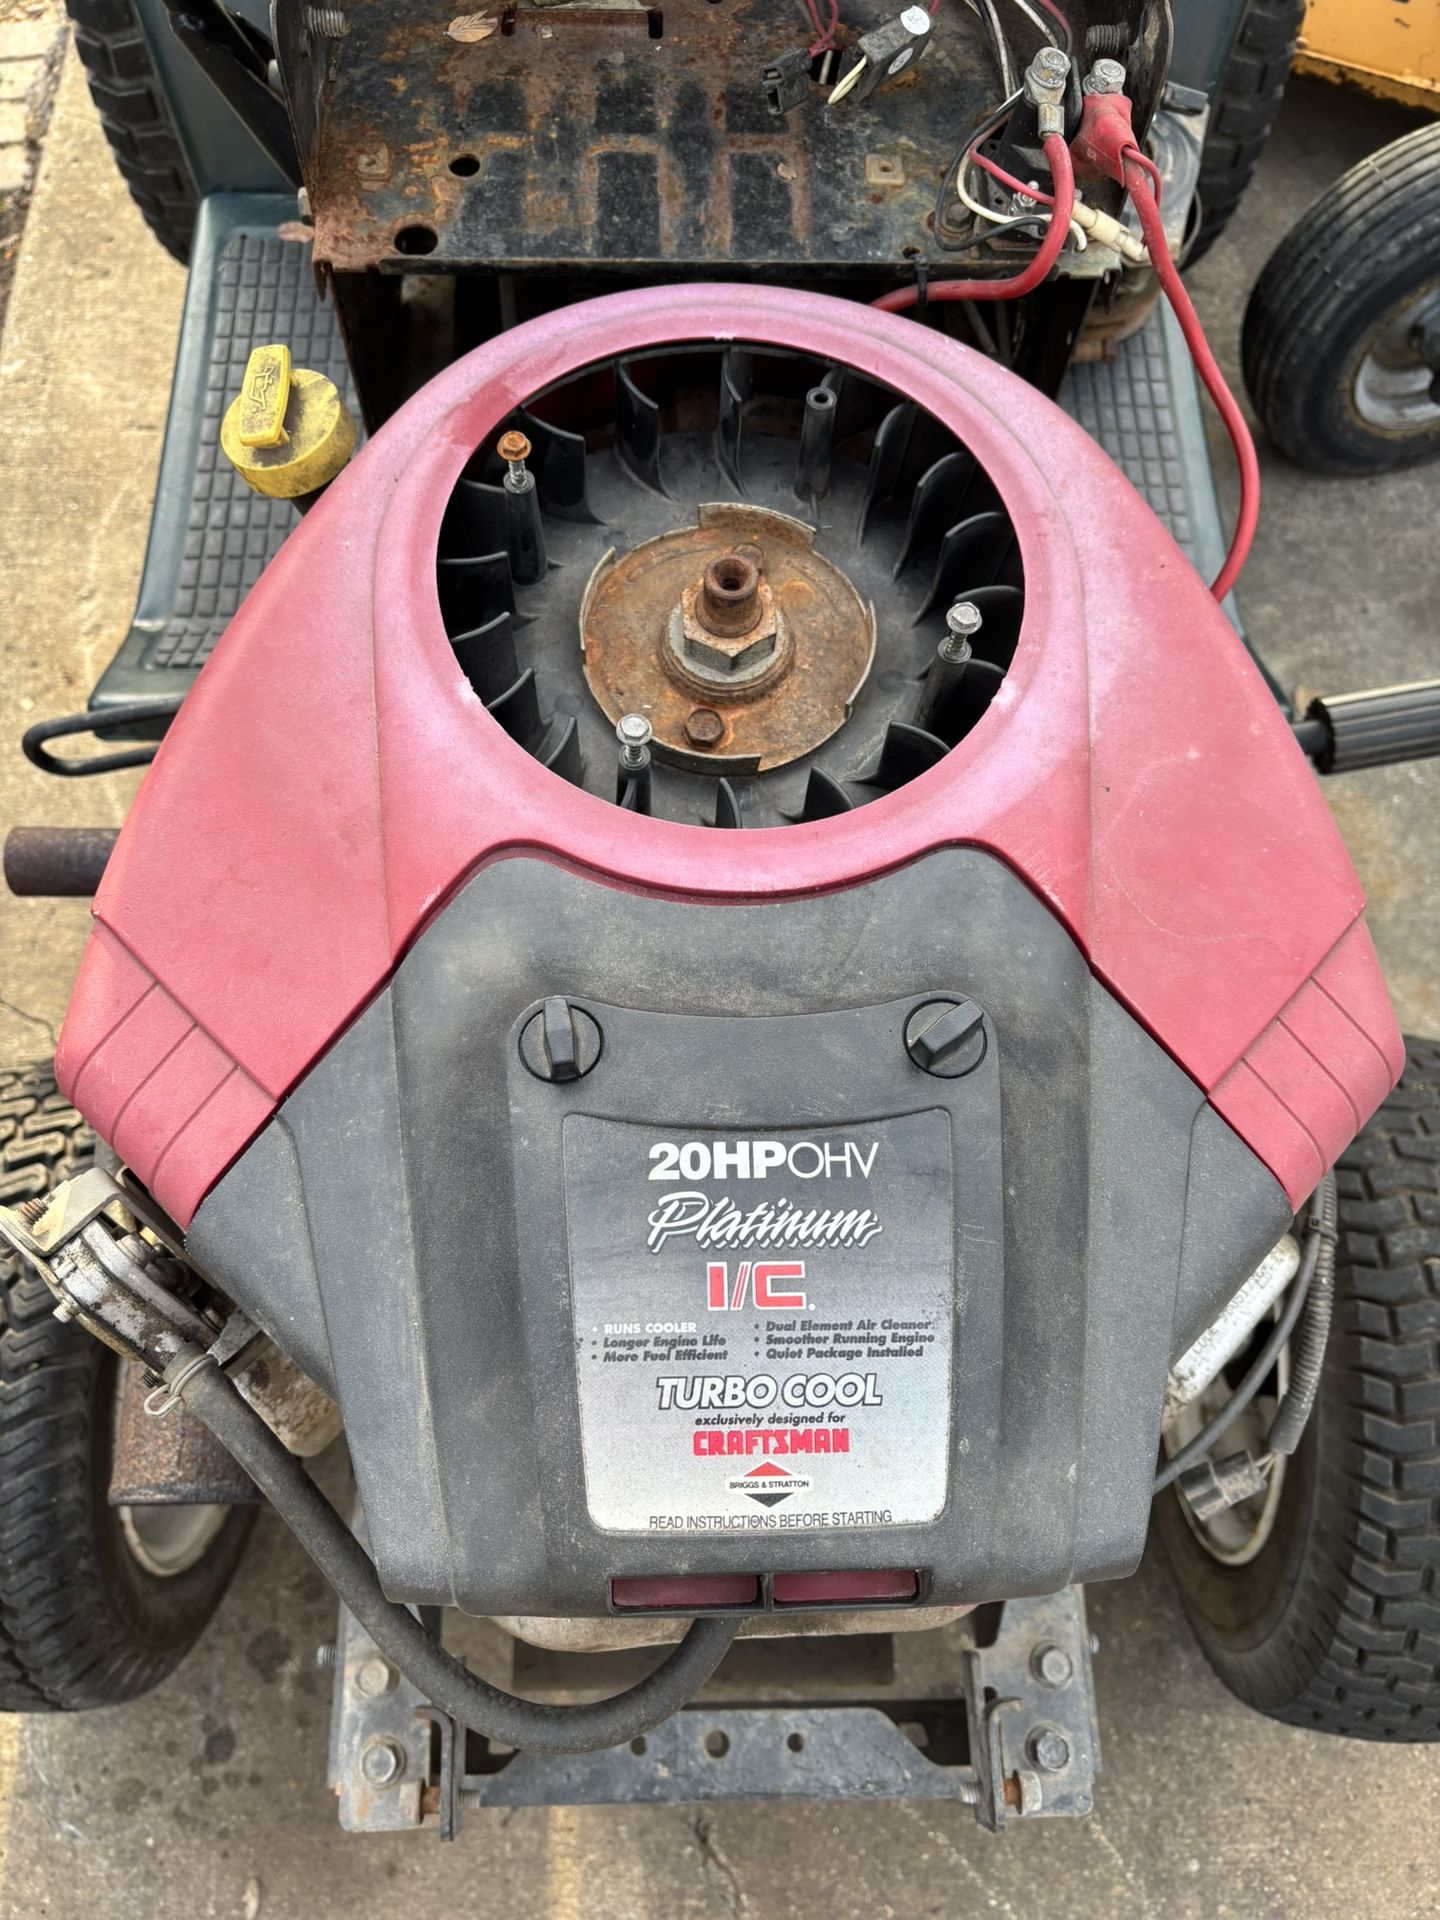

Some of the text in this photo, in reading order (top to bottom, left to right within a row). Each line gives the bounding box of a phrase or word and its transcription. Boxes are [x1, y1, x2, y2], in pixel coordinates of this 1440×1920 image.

[647, 1191, 883, 1253] Platinum
[604, 1322, 697, 1334] RUNS COOLER
[765, 1320, 796, 1331] Dual
[800, 1320, 853, 1331] Element
[857, 1319, 877, 1330] Air
[603, 1334, 727, 1350] Longer Engine Life
[765, 1332, 935, 1346] Smoother Running Engine
[603, 1349, 728, 1362] More Fuel Efficient
[766, 1346, 924, 1360] Quiet Package Installed
[656, 1372, 883, 1410] TURBO COOL
[695, 1411, 846, 1427] exclusively designed for
[693, 1428, 850, 1456] CRAFTSMAN
[729, 1481, 760, 1489] BRIGGS
[768, 1480, 809, 1488] STRATTON
[649, 1510, 892, 1529] READ INSTRUCTIONS BEFORE STARTING
